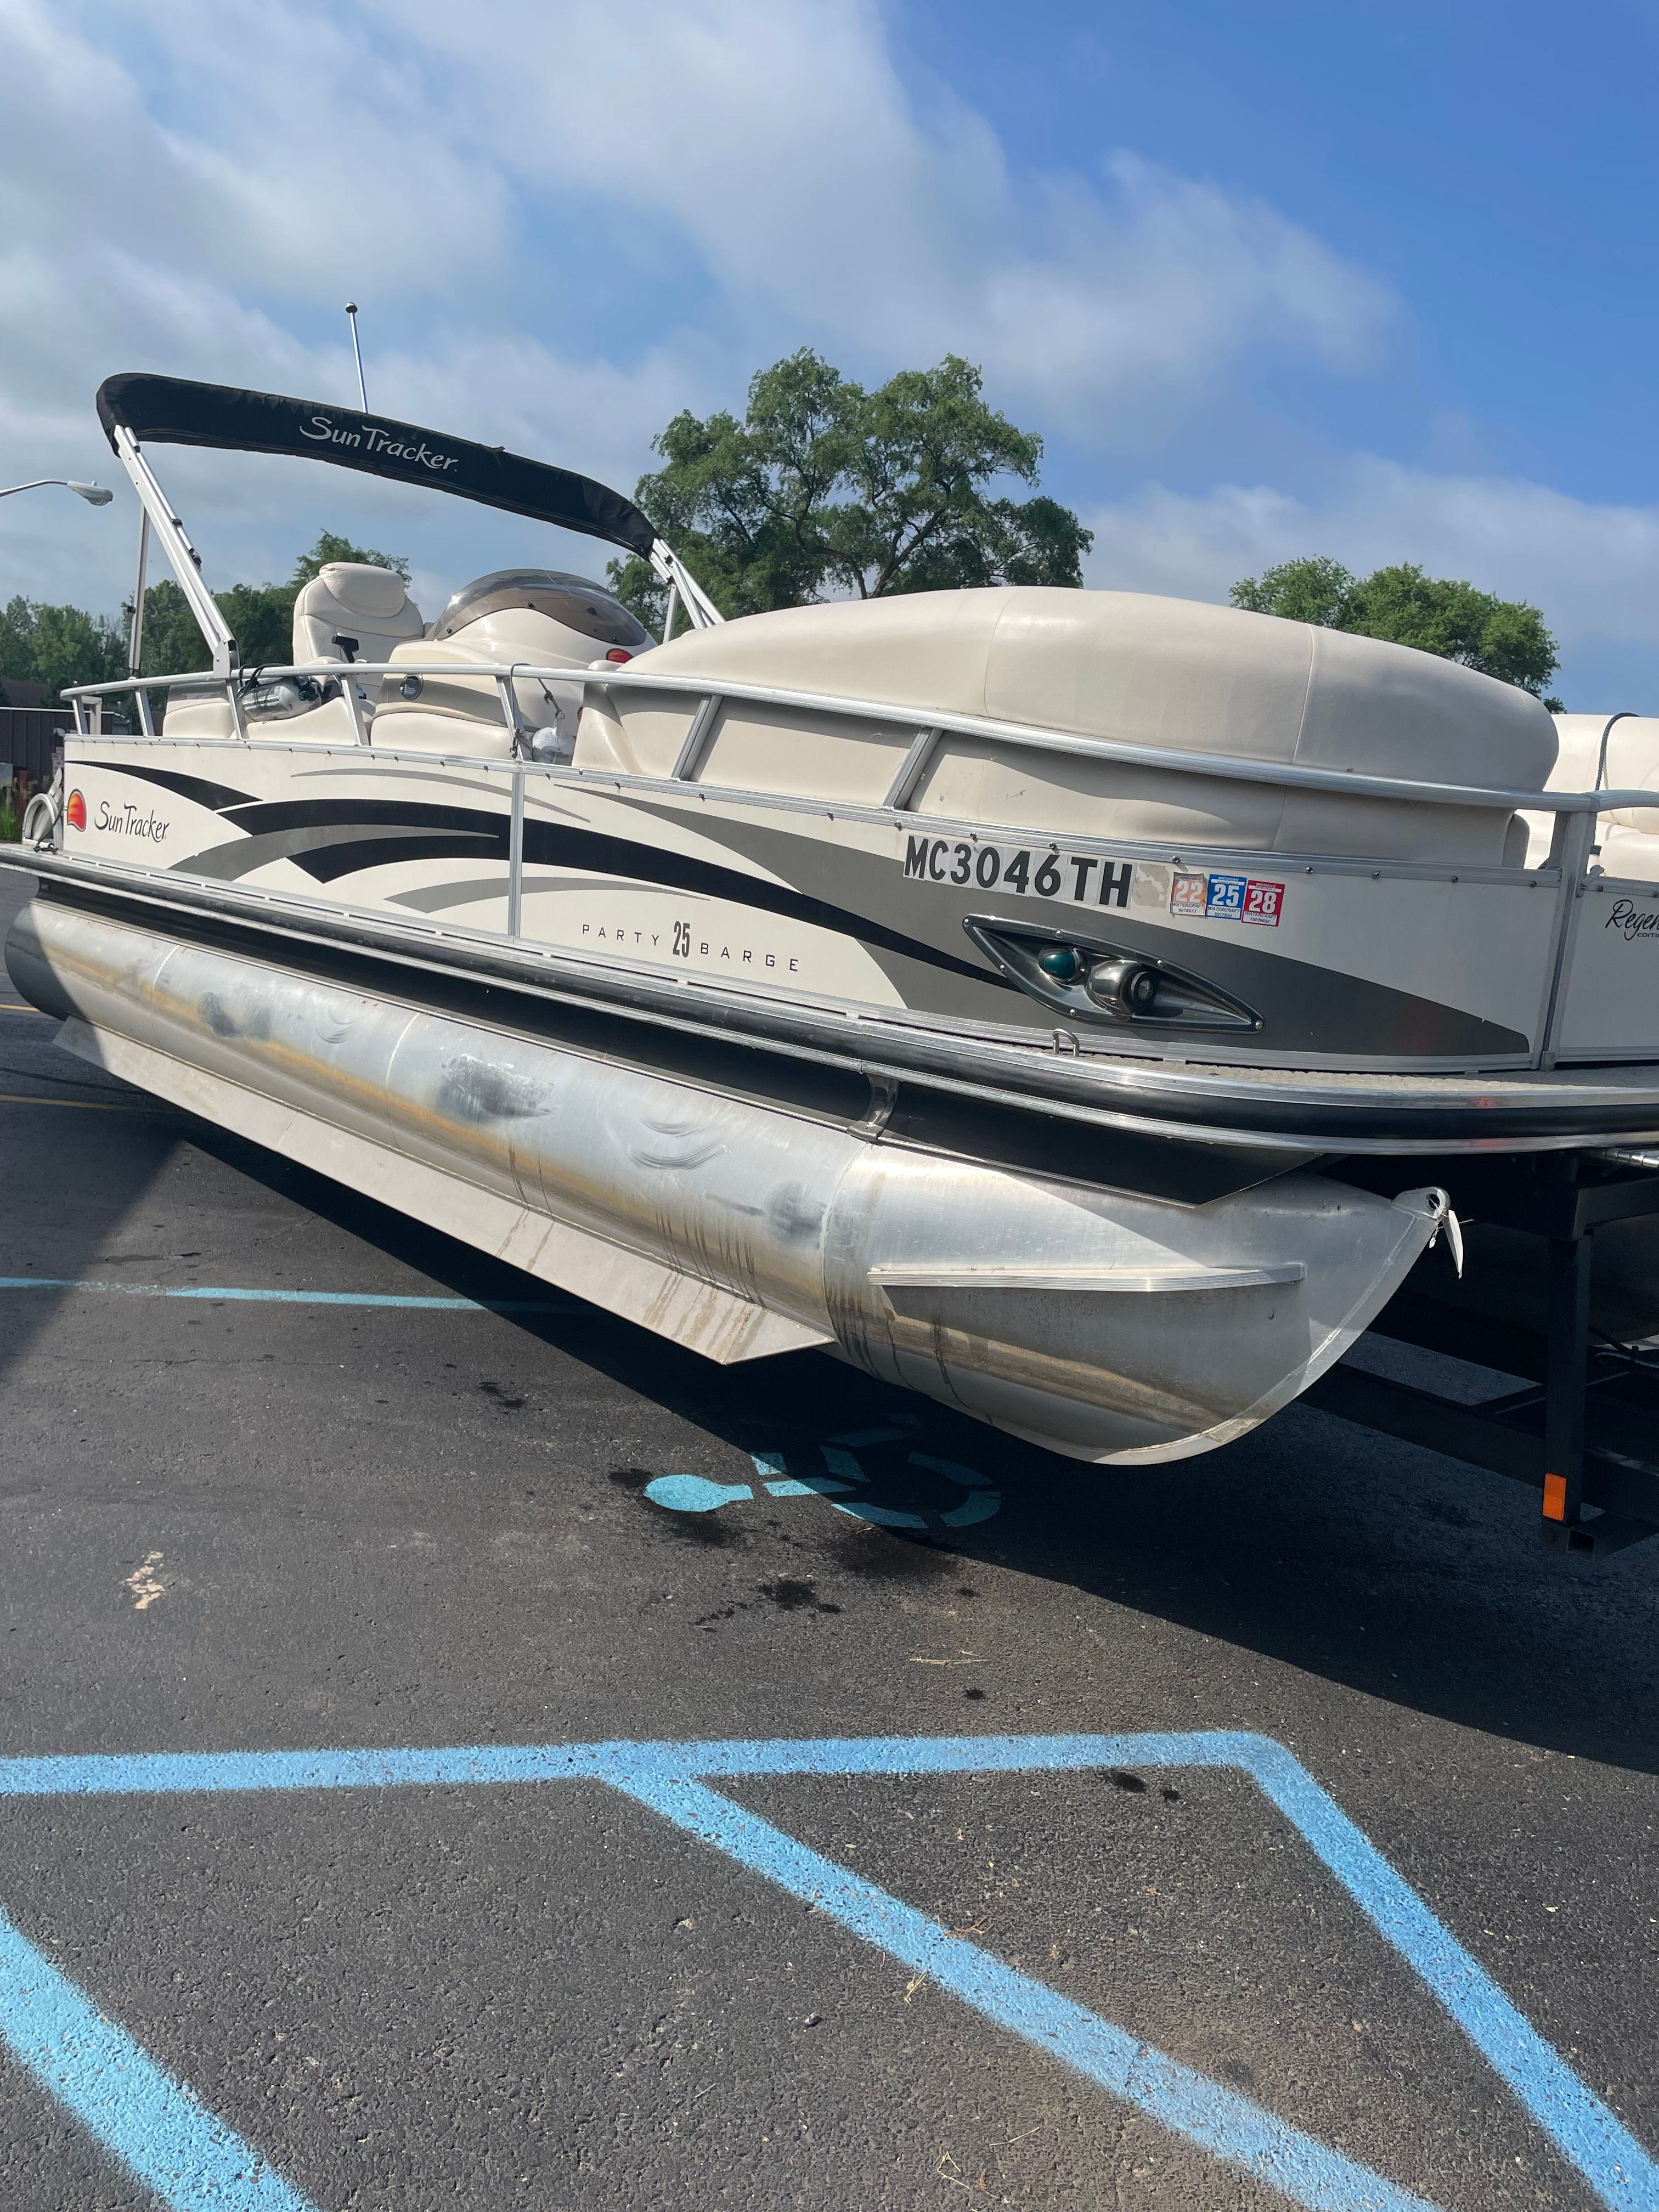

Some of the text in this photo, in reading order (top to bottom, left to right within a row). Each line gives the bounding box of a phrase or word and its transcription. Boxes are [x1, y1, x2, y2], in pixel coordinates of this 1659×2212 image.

[1176, 880, 1203, 903] 22
[1211, 884, 1240, 907] 25
[1248, 890, 1277, 913] 28
[1245, 911, 1277, 919] WATERCRAFT
[582, 921, 799, 972] PARTY 25 BARGE
